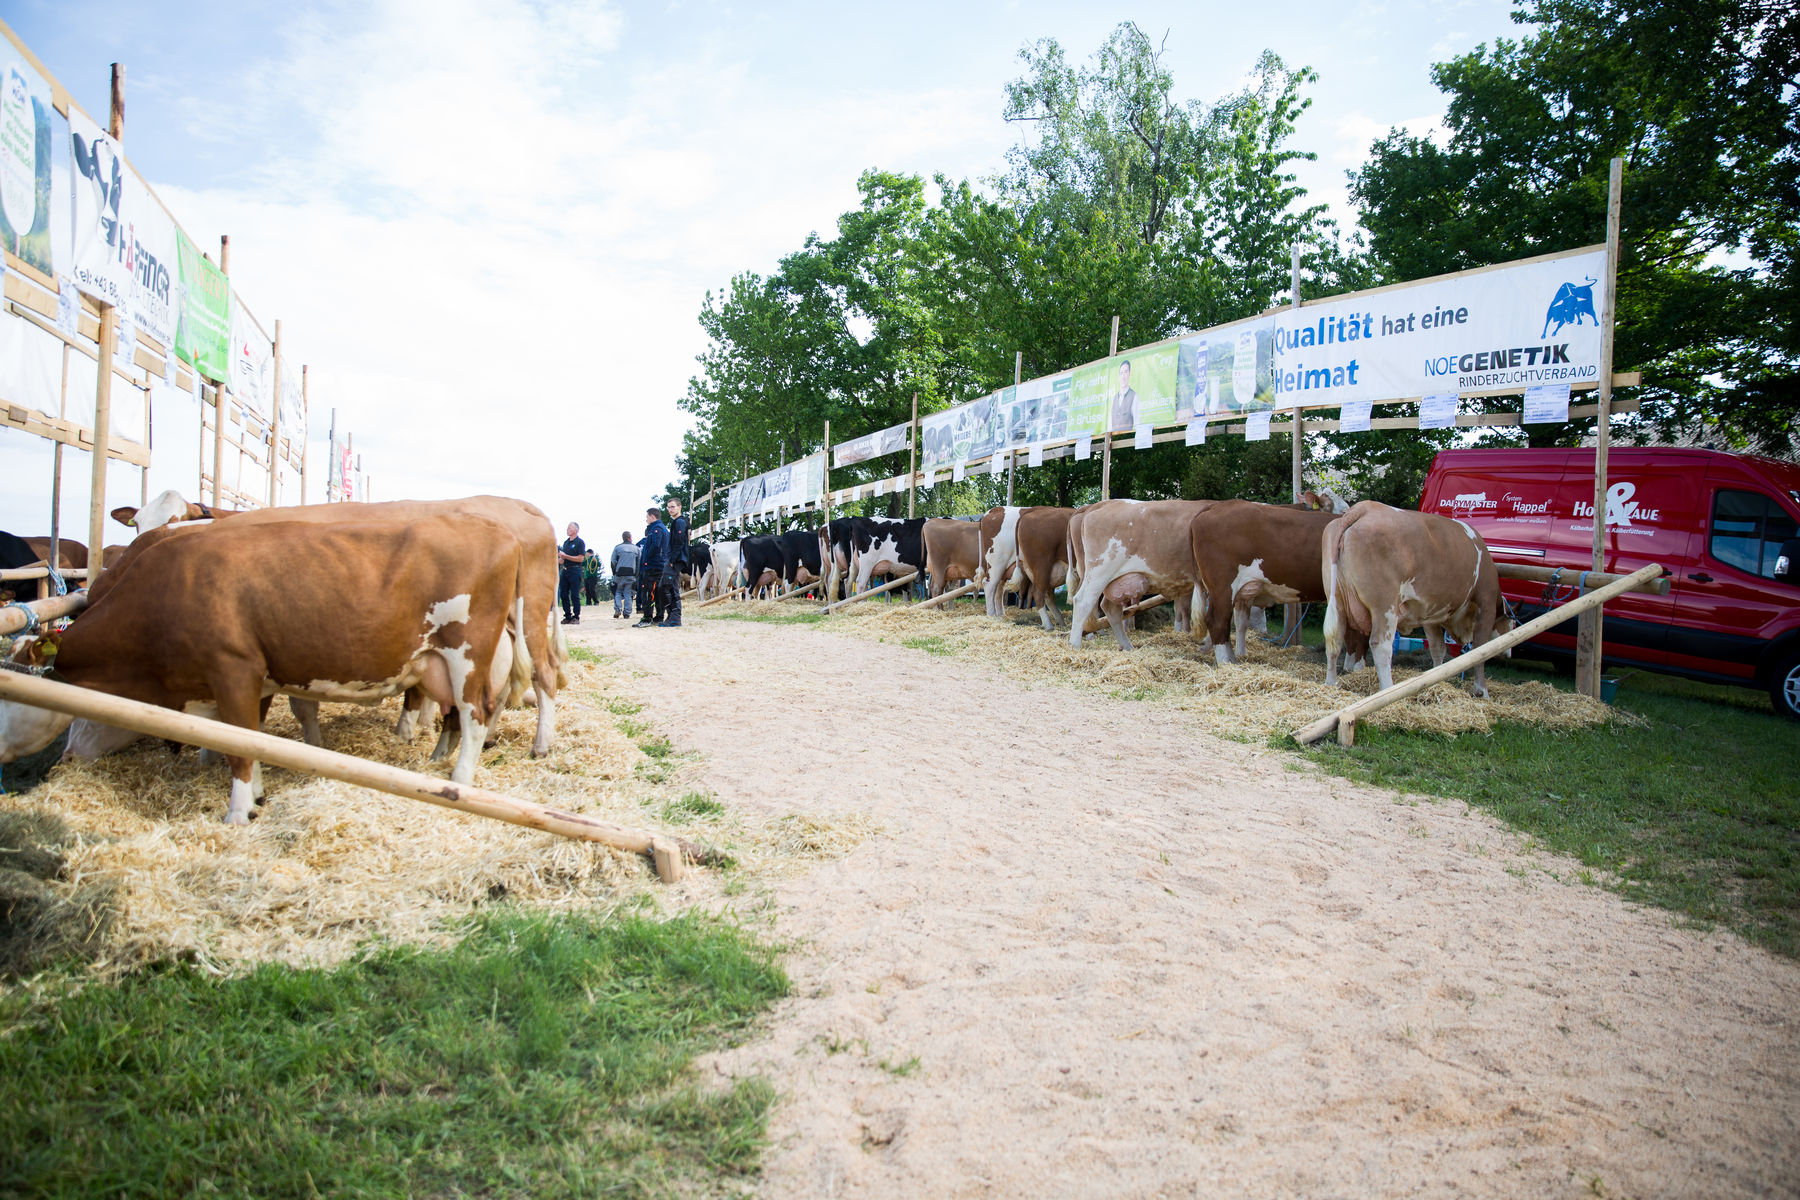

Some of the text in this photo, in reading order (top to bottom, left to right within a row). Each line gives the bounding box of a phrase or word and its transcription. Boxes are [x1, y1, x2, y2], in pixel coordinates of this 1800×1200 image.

[1275, 305, 1469, 355] Qualität hat eine
[1275, 359, 1360, 394] Heimat
[1459, 364, 1598, 388] RINDERZUCHTVERBAND
[1439, 498, 1498, 509] DAIRYMASTER
[1505, 495, 1523, 503] System
[1512, 500, 1548, 514] Happel
